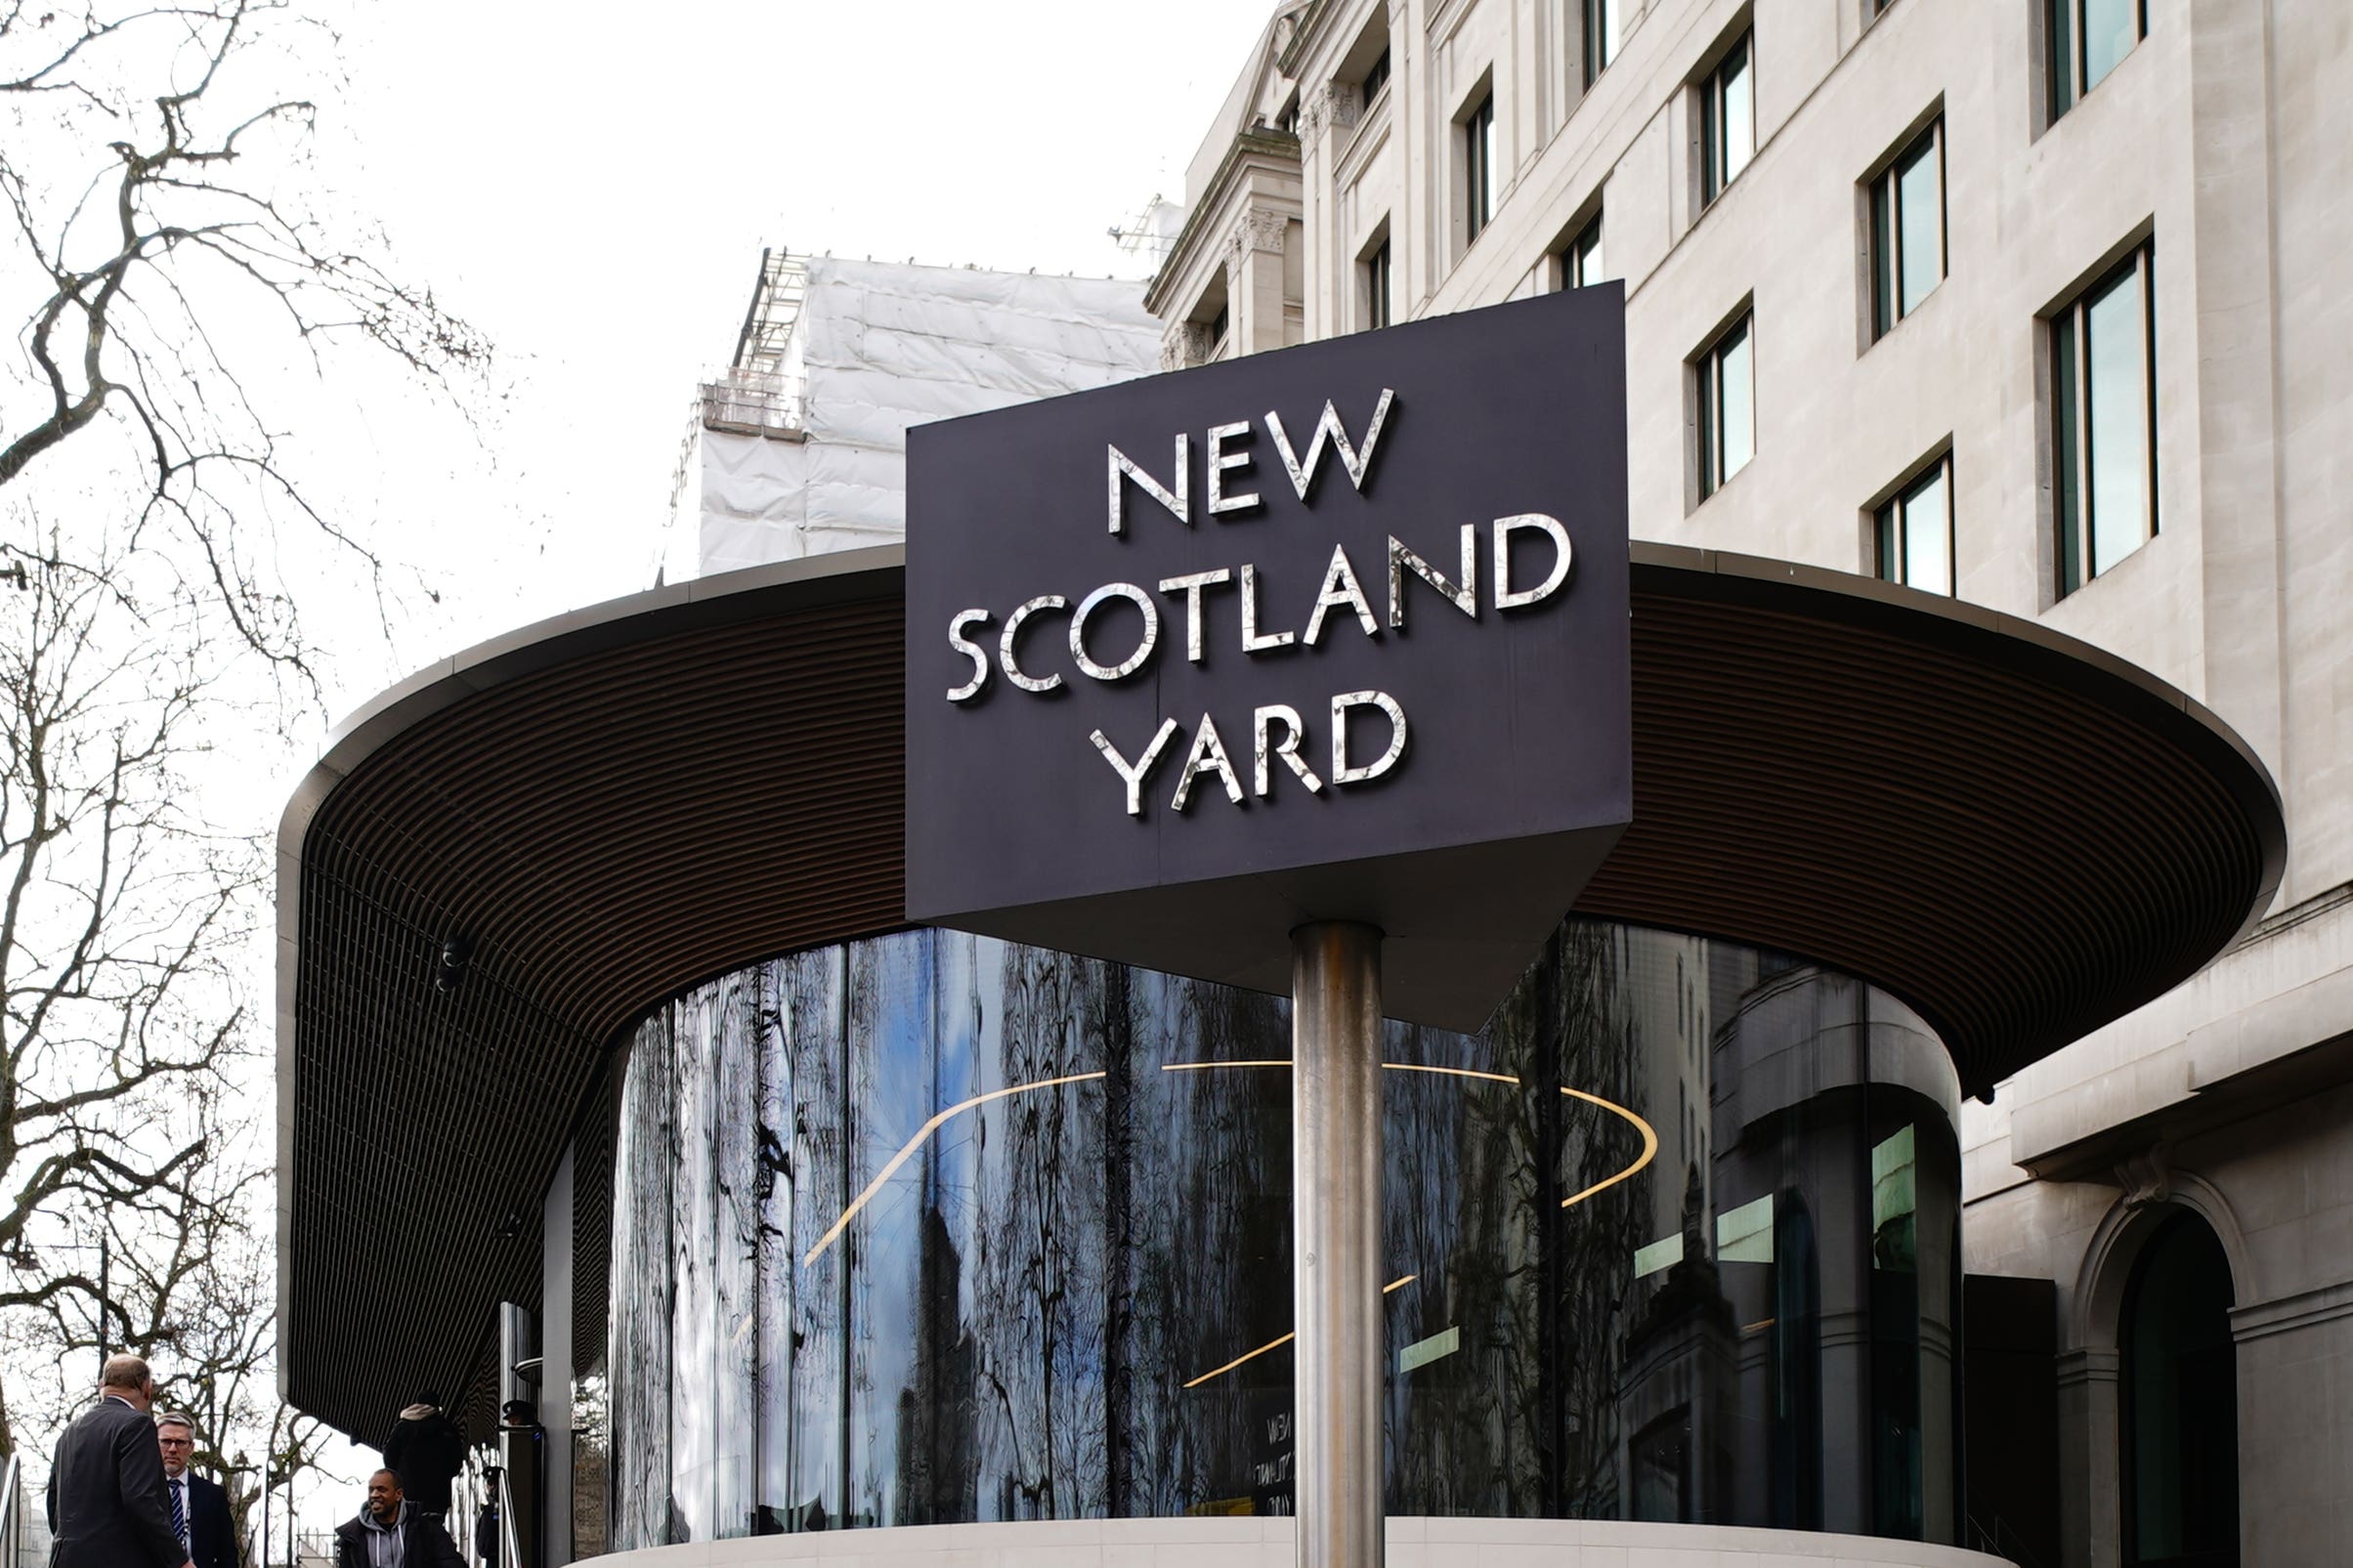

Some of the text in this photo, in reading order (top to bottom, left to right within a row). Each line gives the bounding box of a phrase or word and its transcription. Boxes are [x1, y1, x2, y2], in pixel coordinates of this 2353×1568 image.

[1107, 388, 1396, 538] NEW
[946, 512, 1572, 704] SCOTLAND
[1089, 690, 1407, 816] YARD
